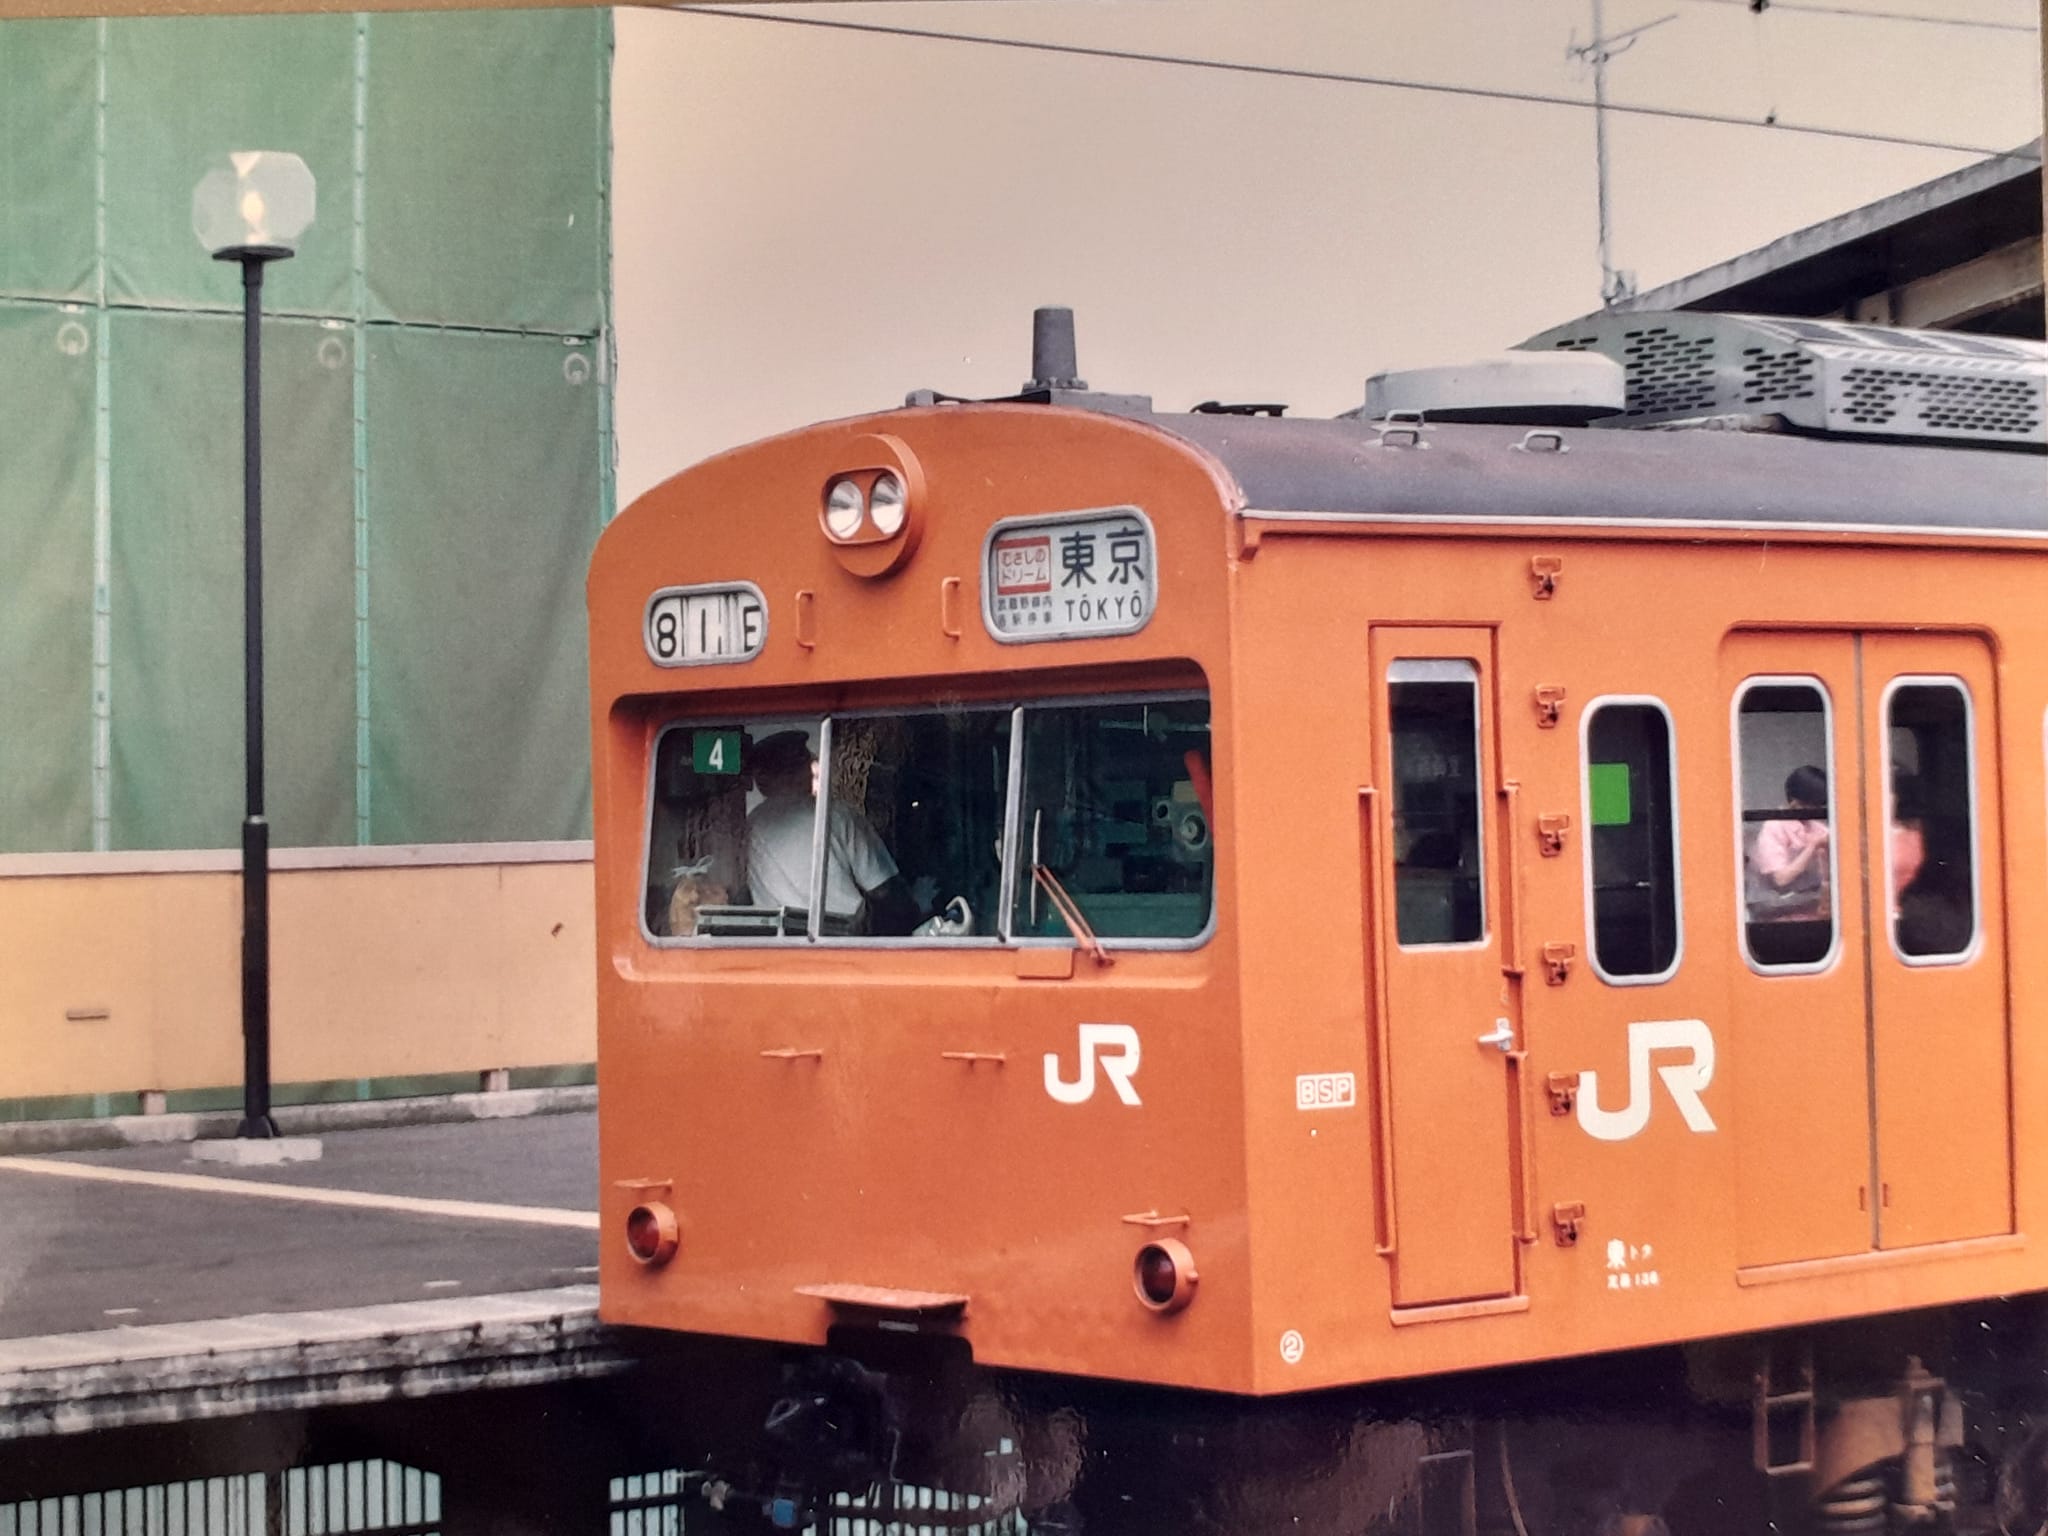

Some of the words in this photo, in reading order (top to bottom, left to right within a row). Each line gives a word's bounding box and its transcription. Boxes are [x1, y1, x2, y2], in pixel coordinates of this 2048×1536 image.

[1001, 547, 1047, 567] むさしの
[1060, 526, 1145, 588] 東京
[1001, 568, 1047, 584] ドリーム
[709, 738, 723, 770] 4
[1044, 1023, 1142, 1105] JR
[1576, 1019, 1717, 1141] JR
[1299, 1077, 1351, 1105] BSP
